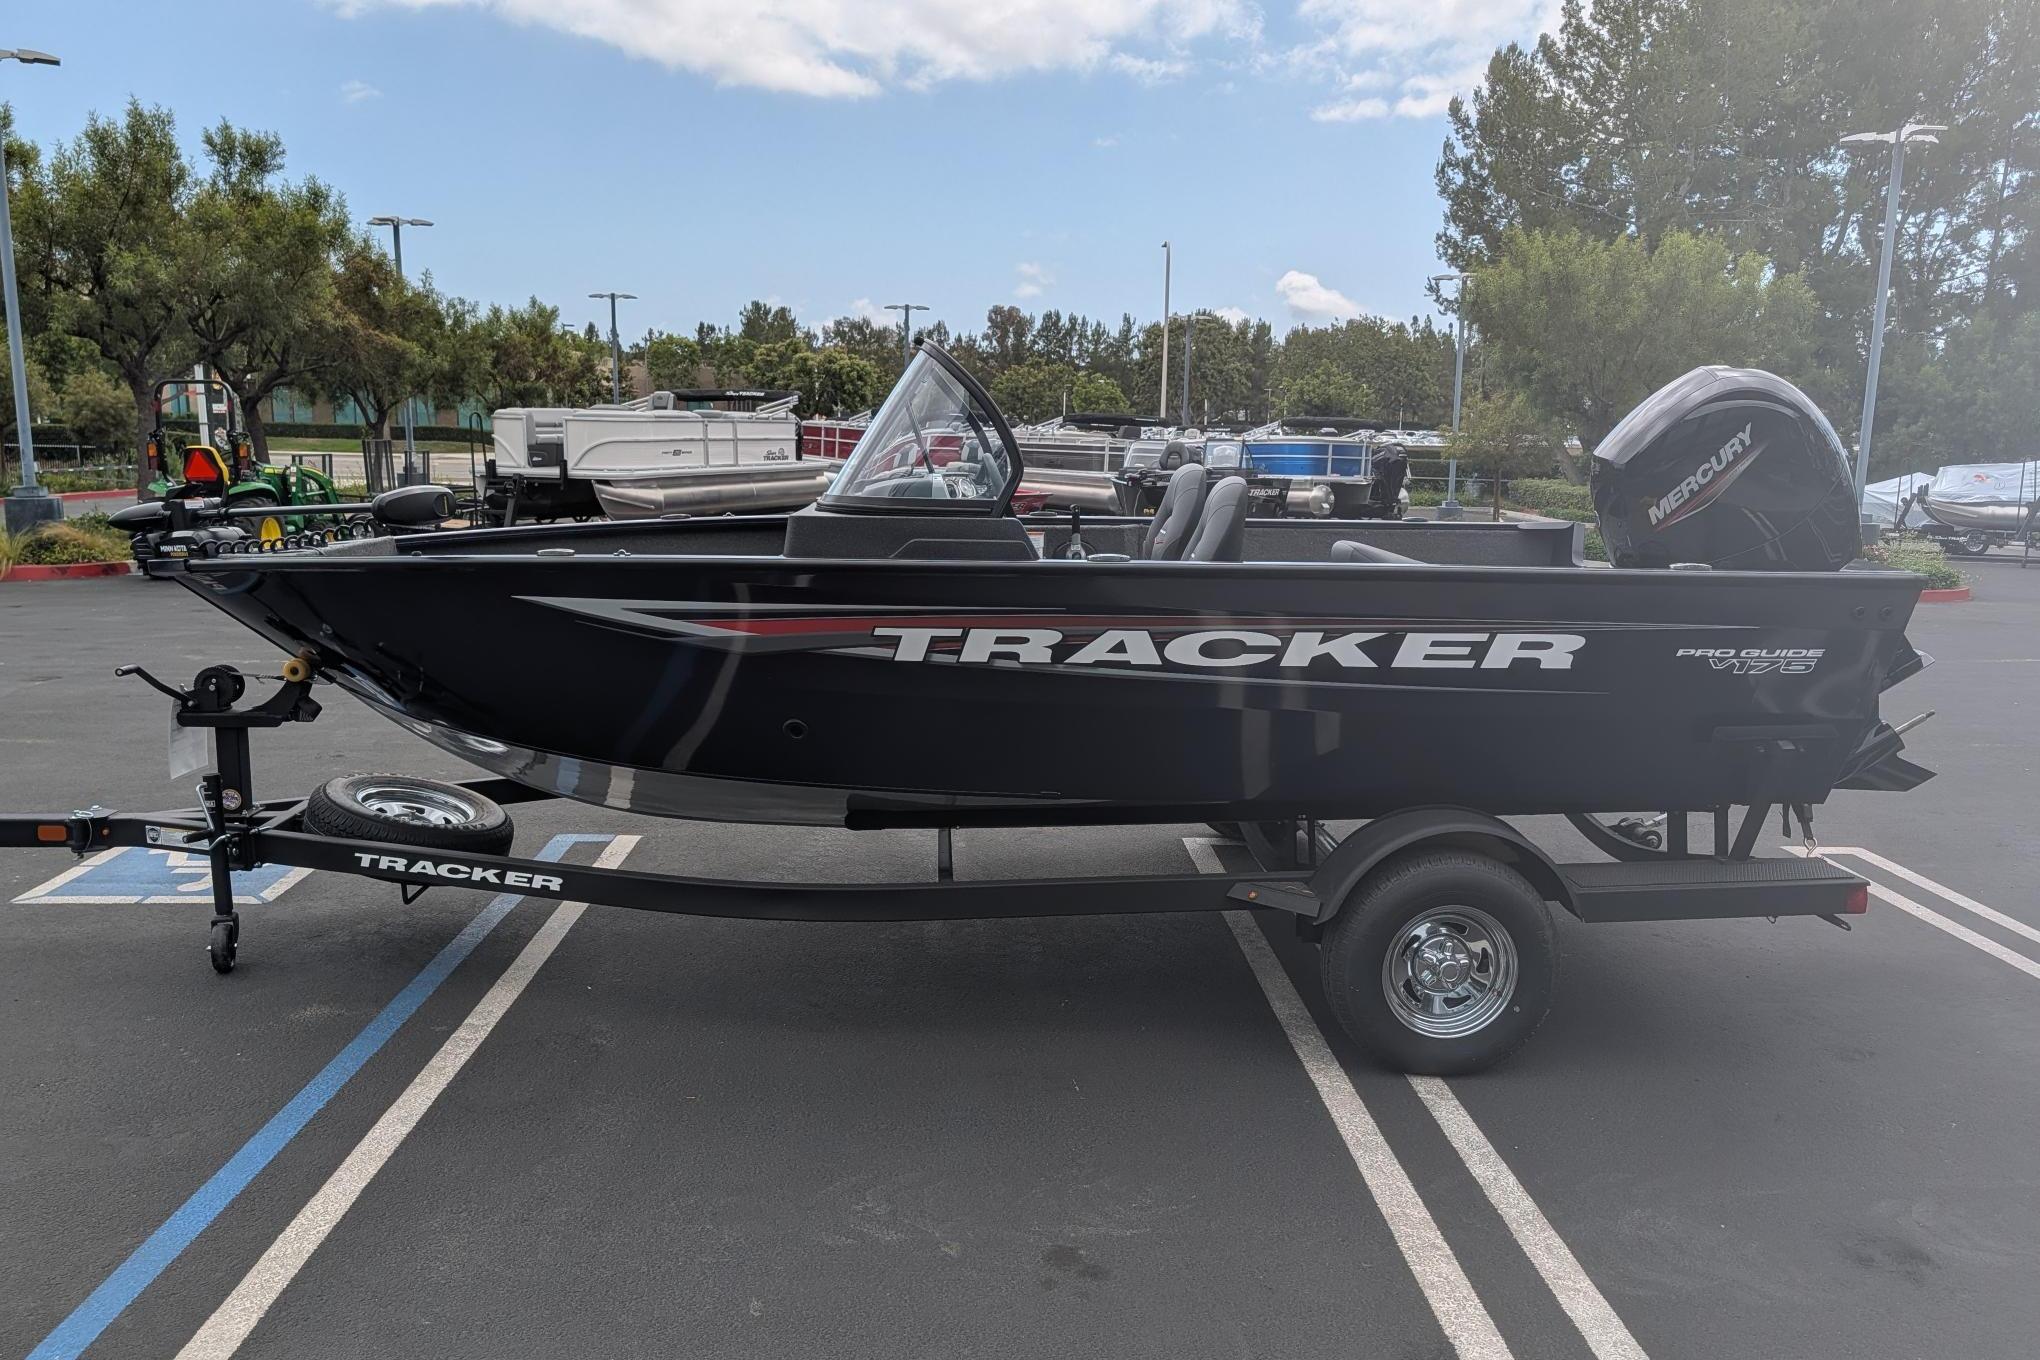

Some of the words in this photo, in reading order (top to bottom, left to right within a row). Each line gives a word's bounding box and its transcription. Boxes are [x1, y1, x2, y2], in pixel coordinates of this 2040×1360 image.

[1647, 422, 1752, 526] MERCURY
[1248, 488, 1280, 496] TRACKER
[873, 627, 1586, 669] TRACKER
[1675, 648, 1736, 657] PRO
[1739, 648, 1826, 657] GUIDE
[1708, 658, 1818, 674] V175
[354, 852, 564, 892] TRACKER
